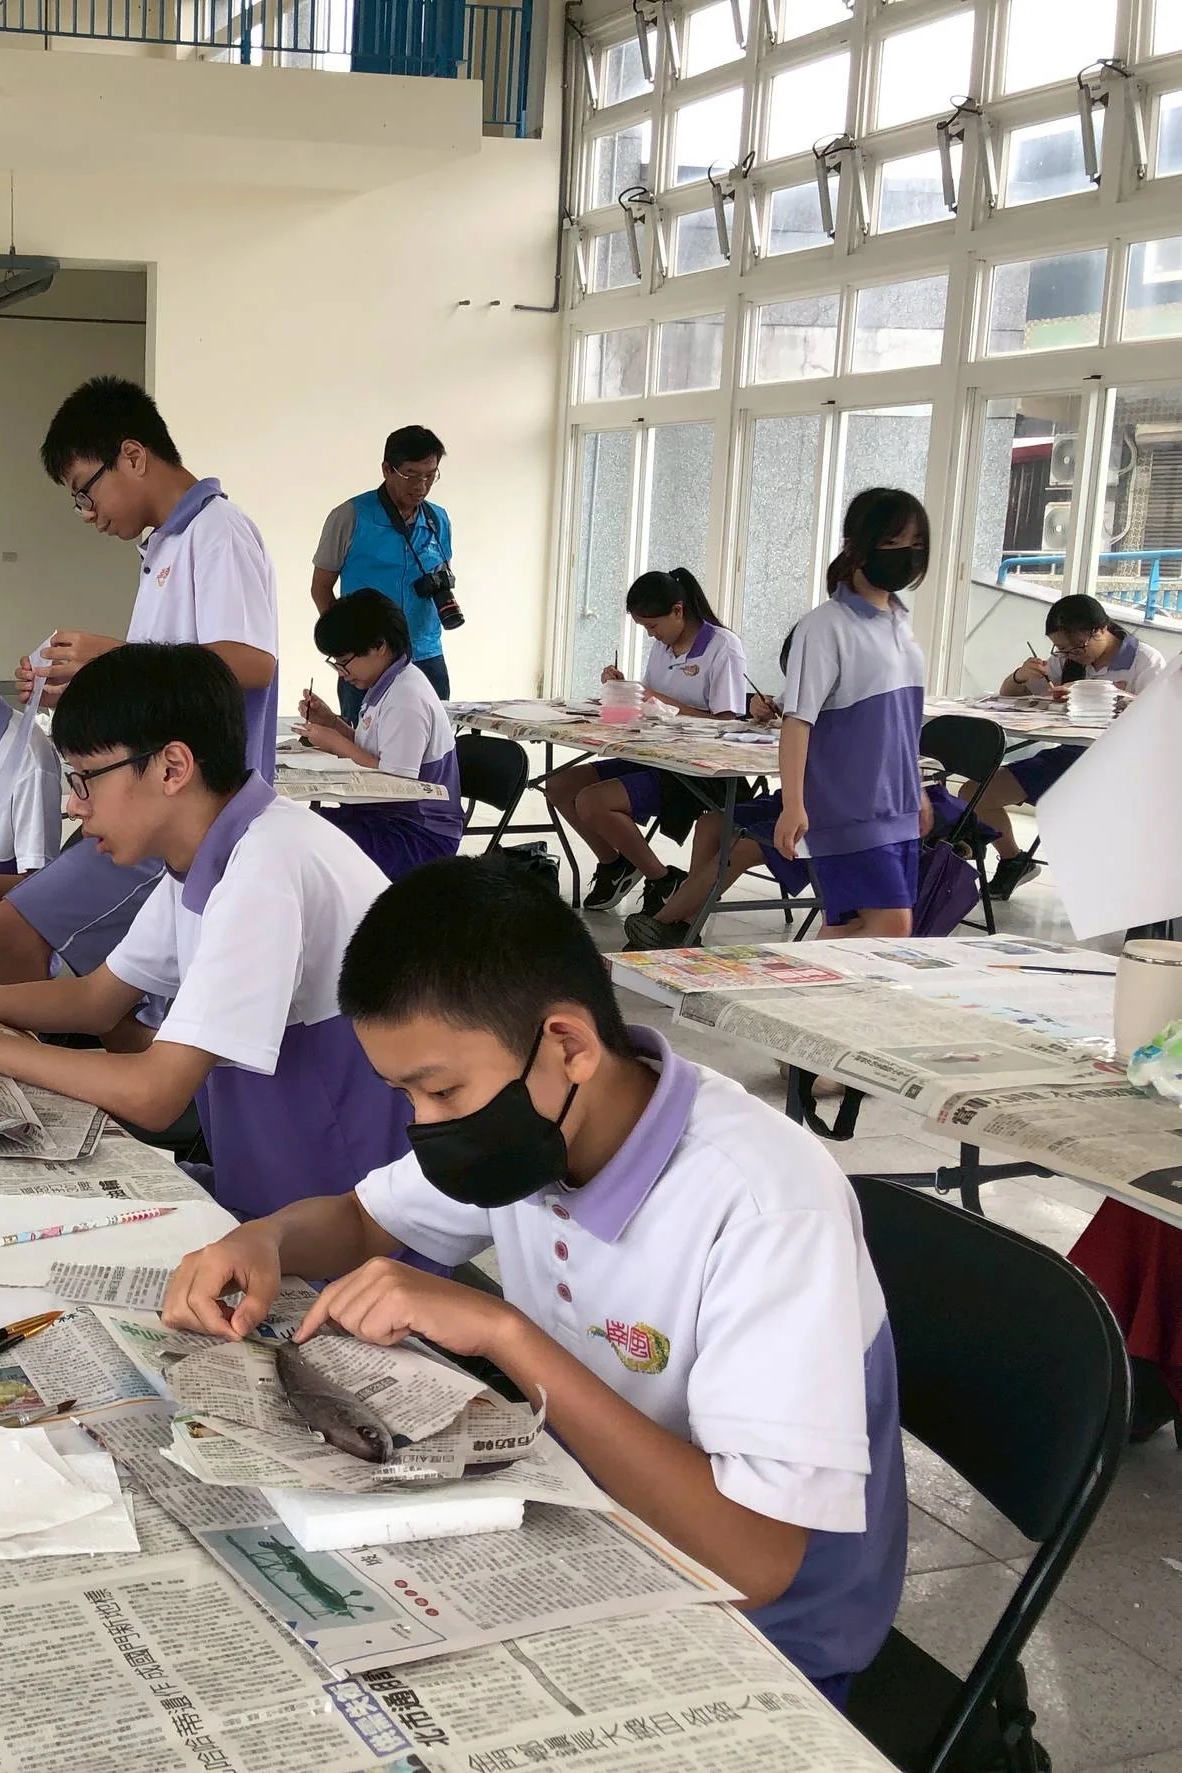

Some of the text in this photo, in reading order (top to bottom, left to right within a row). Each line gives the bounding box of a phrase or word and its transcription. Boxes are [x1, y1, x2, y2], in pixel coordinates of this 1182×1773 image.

[83, 1588, 168, 1680] 成國門新地標
